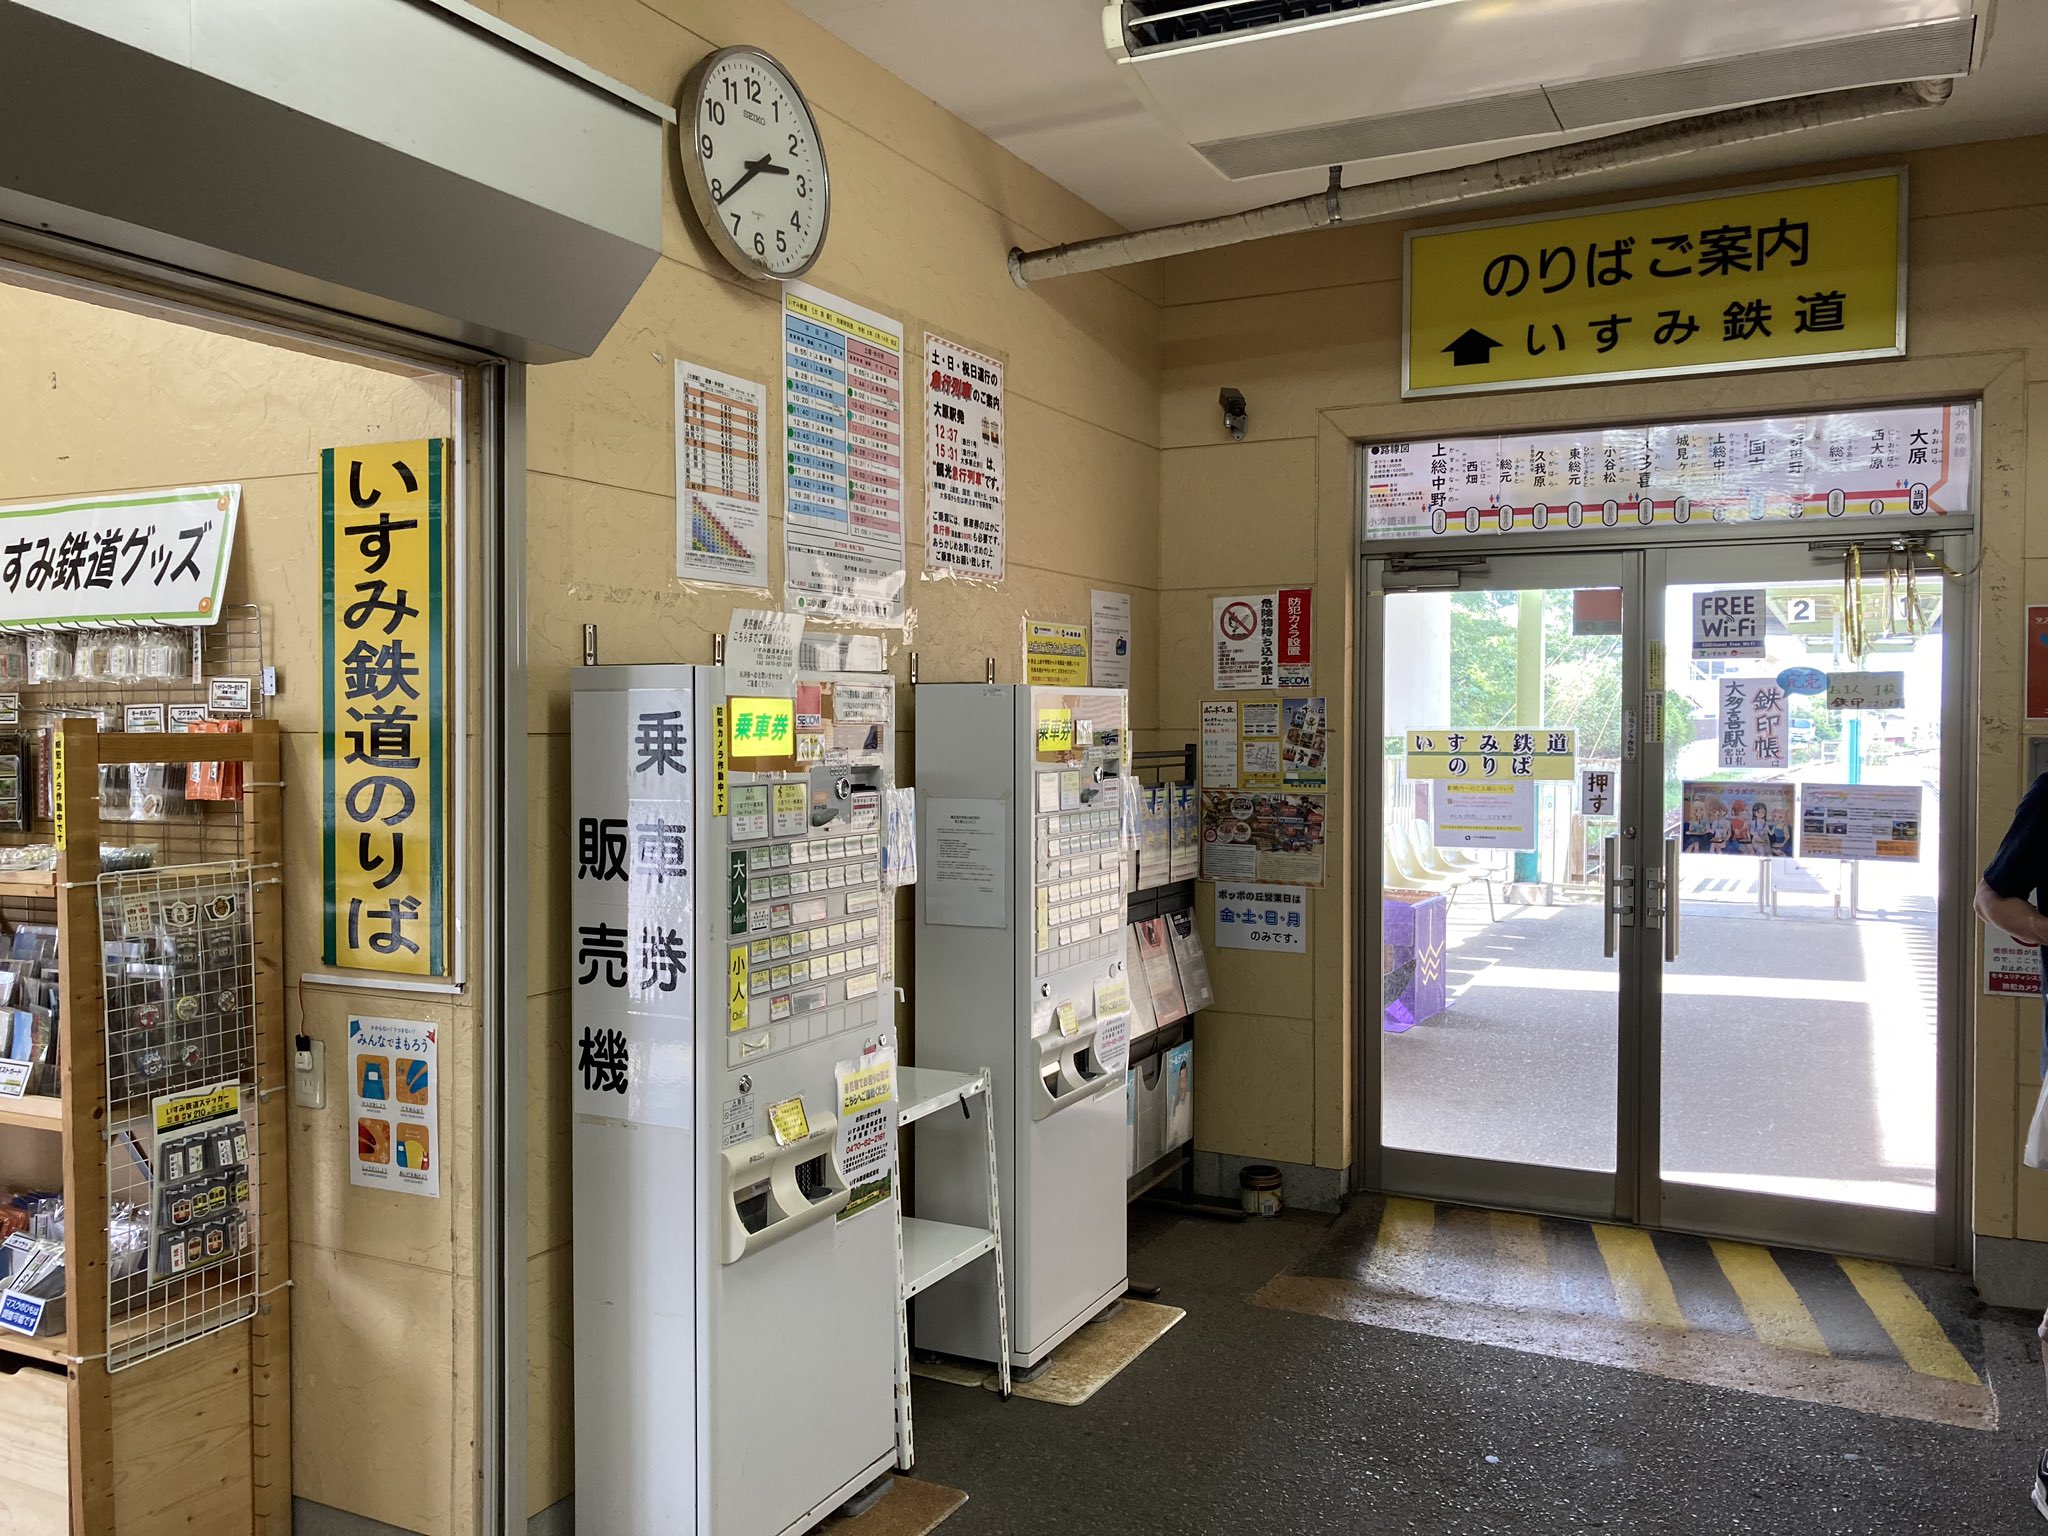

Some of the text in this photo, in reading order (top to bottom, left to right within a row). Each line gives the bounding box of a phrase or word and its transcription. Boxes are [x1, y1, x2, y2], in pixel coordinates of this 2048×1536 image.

[723, 77, 738, 104] 11
[744, 77, 761, 104] 12
[704, 97, 725, 125] 10
[743, 109, 766, 126] SEIKO
[771, 100, 778, 123] 1
[701, 134, 713, 159] 9
[788, 133, 798, 157] 2
[711, 178, 722, 203] 8
[796, 174, 807, 198] 3
[730, 212, 741, 236] 7
[790, 210, 801, 232] 4
[754, 232, 765, 256] 6
[776, 230, 787, 253] 5
[1482, 217, 1810, 297] のりばご案内
[1528, 290, 1846, 355] いすみ鉄道
[936, 423, 958, 443] 12:37
[936, 443, 958, 461] 15:31
[1380, 444, 1410, 455] 路線図
[1675, 434, 1690, 482] 城見ヶ
[1869, 428, 1885, 470] 西大原
[1908, 428, 1929, 465] 大原
[1430, 443, 1447, 507] 上総中野
[1466, 461, 1479, 485] 西畑
[1500, 459, 1512, 483] 総元
[1533, 450, 1547, 487] 久我原
[1568, 447, 1582, 486] 東総元
[1604, 445, 1617, 484] 小谷松
[1912, 489, 1924, 510] 当駅
[3, 519, 213, 593] すみ鉄道グッズ
[1701, 596, 1755, 616] FREE
[1793, 600, 1810, 621] 2
[1287, 597, 1302, 656] 防犯カメラ設置
[1701, 617, 1756, 638] Wi-Fi
[1260, 598, 1273, 686] 危険物持ち込み禁止
[1278, 677, 1310, 685] SECOM
[1785, 670, 1822, 690] 完売
[342, 460, 422, 954] いすみ鉄道のりば
[1722, 680, 1748, 748] 大多喜駅
[733, 712, 789, 741] 乗車券
[797, 715, 820, 726] SECOM
[1752, 687, 1784, 761] 鉄印帳
[1414, 732, 1571, 755] いすみ鉄道
[716, 706, 725, 814] 防犯カメラ作動中です
[1447, 755, 1533, 777] のりば
[55, 741, 64, 843] 防犯カメラ作動中です
[1587, 772, 1608, 814] 押す
[634, 710, 689, 993] 乗車券
[732, 858, 746, 906] 大人
[1218, 890, 1302, 904] ポッポの丘営業日は
[1250, 931, 1298, 944] のみです。
[577, 817, 630, 1097] 販売機
[732, 956, 745, 1002] 小人
[1992, 973, 2041, 981] セキュリティシス
[357, 1033, 429, 1053] みんなでまもろう
[166, 1095, 230, 1115] いすみ鉄道ステッカー
